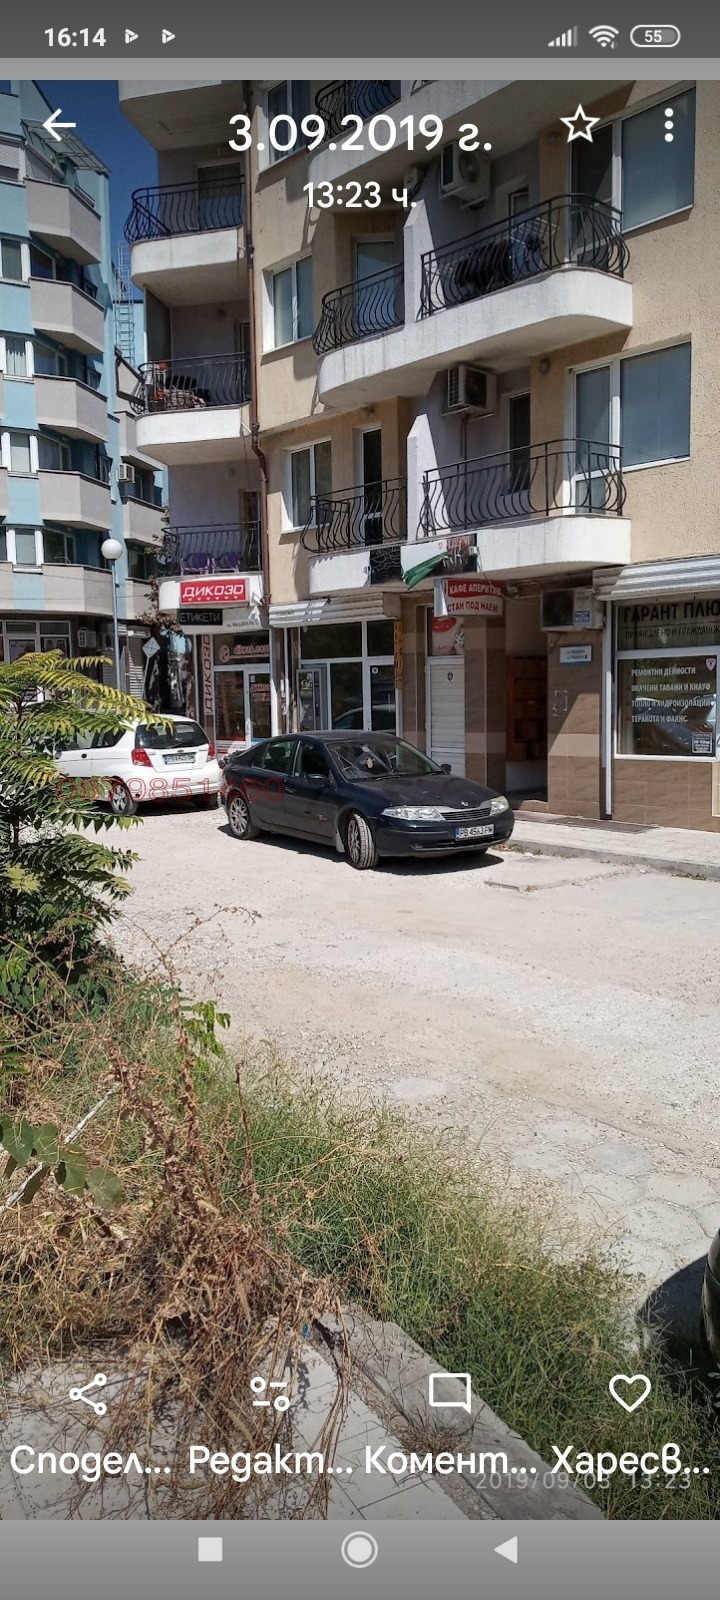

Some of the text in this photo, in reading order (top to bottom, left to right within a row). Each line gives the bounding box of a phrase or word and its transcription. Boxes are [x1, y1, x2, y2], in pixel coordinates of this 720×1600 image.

[183, 584, 244, 598] ДИКОЗО
[450, 584, 502, 596] КАФЕ АПЕРИТИВ
[447, 601, 498, 612] СТАИ ПОД НАЕМ
[179, 611, 221, 623] ЕТИКЕТИ
[623, 603, 680, 623] ГАРАНТ
[202, 633, 213, 712] ДИКОЗО
[631, 666, 696, 677] РЕМОНТНИ ДЕЙНОСТИ
[631, 683, 711, 692] ОКАЧЕНИ ТАВАНИ И КНАУФ
[631, 700, 651, 708] ТОПЛО
[631, 715, 688, 723] ТЕРАКОТА И ФАЯНС
[459, 828, 469, 837] PB
